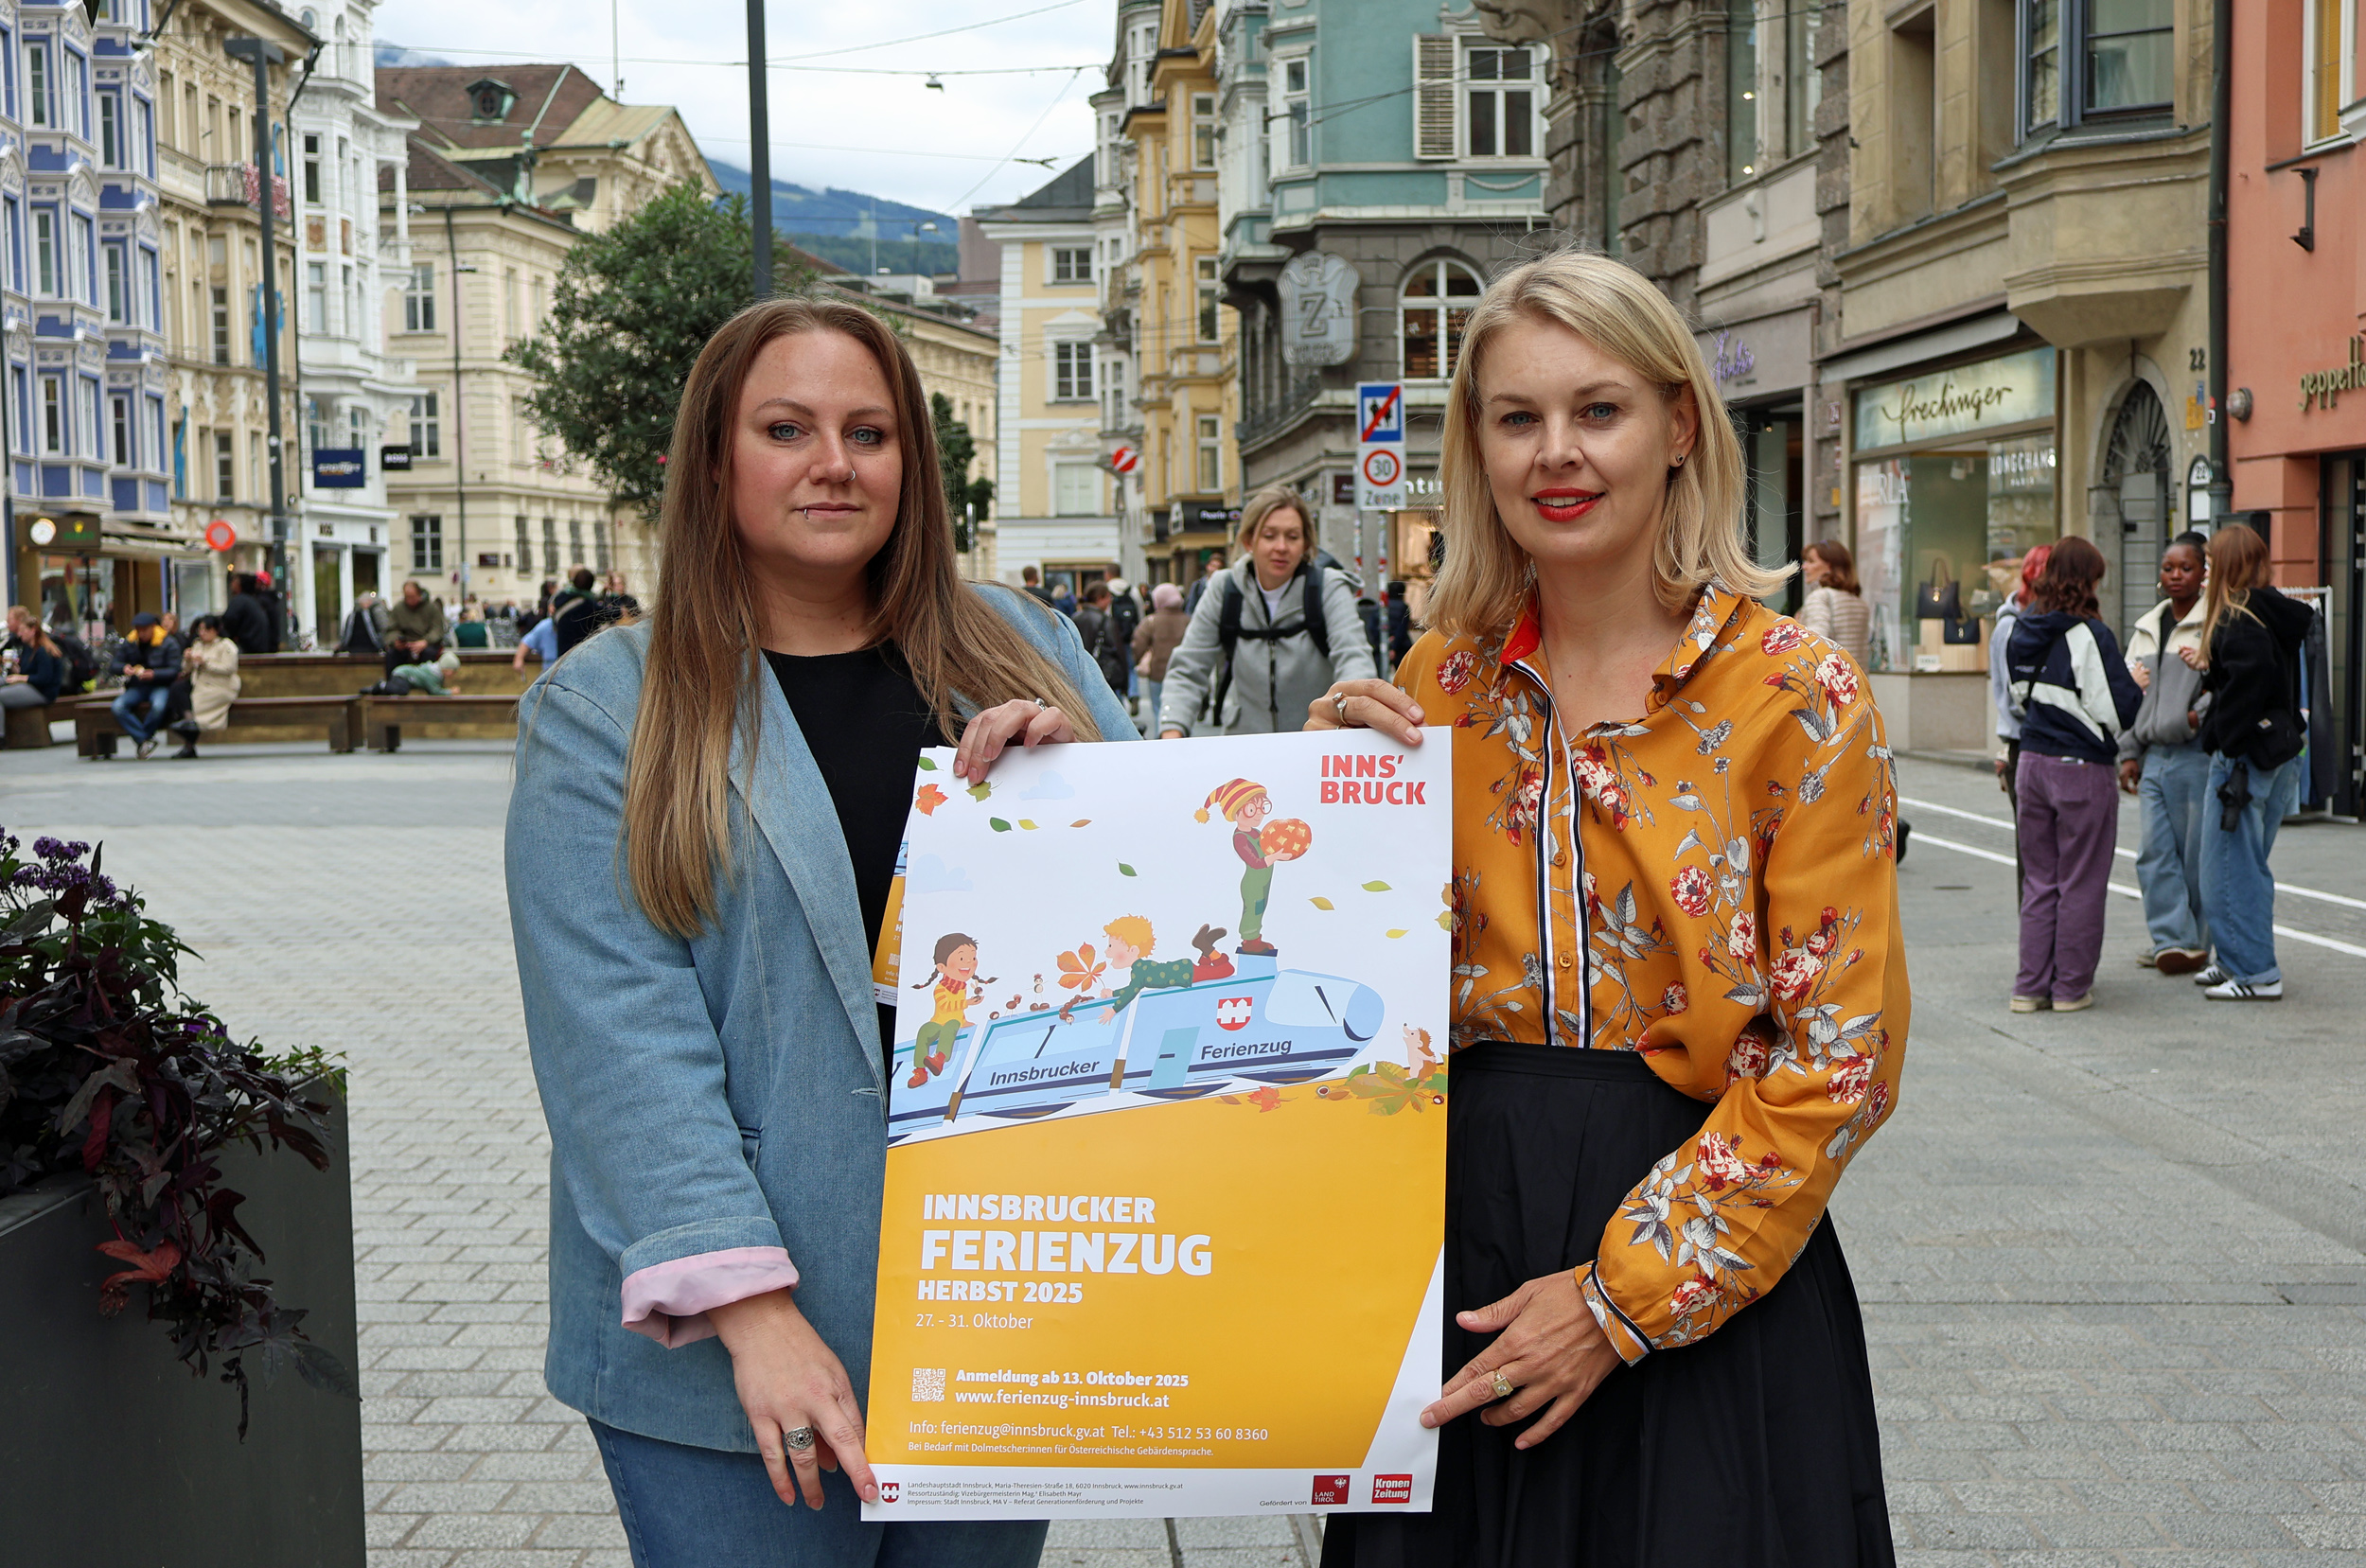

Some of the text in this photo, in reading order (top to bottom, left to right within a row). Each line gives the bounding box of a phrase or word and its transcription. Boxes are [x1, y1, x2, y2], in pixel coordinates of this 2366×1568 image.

[2189, 347, 2205, 371] 22
[1372, 459, 1391, 476] 30
[2196, 466, 2207, 480] 22
[1365, 490, 1401, 506] Zone
[1320, 781, 1426, 805] BRUCK
[1200, 1039, 1293, 1061] Ferienzug
[989, 1058, 1101, 1086] Innsbrucker
[923, 1193, 1156, 1224] INNSBRUCKER
[920, 1229, 1212, 1277] FERIENZUG
[917, 1279, 1084, 1304] HERBST 2025
[915, 1313, 935, 1328] 27.
[947, 1313, 969, 1328] 31.
[972, 1312, 1034, 1330] Oktober
[955, 1368, 1190, 1387] Anmeldung ab 13. Oktober 2025
[954, 1388, 1170, 1410] www.ferienzug-innsbruck.at
[909, 1419, 1269, 1441] Info: ferienzug@innsbruck.gv.at Tel.: +43 512 53 60 8360
[908, 1441, 1214, 1458] Bei Bedarf mit Dolmetscher:innen für Österreichische Gebärdensprache.
[1374, 1489, 1409, 1499] Zeitung
[1375, 1478, 1410, 1489] Kronen
